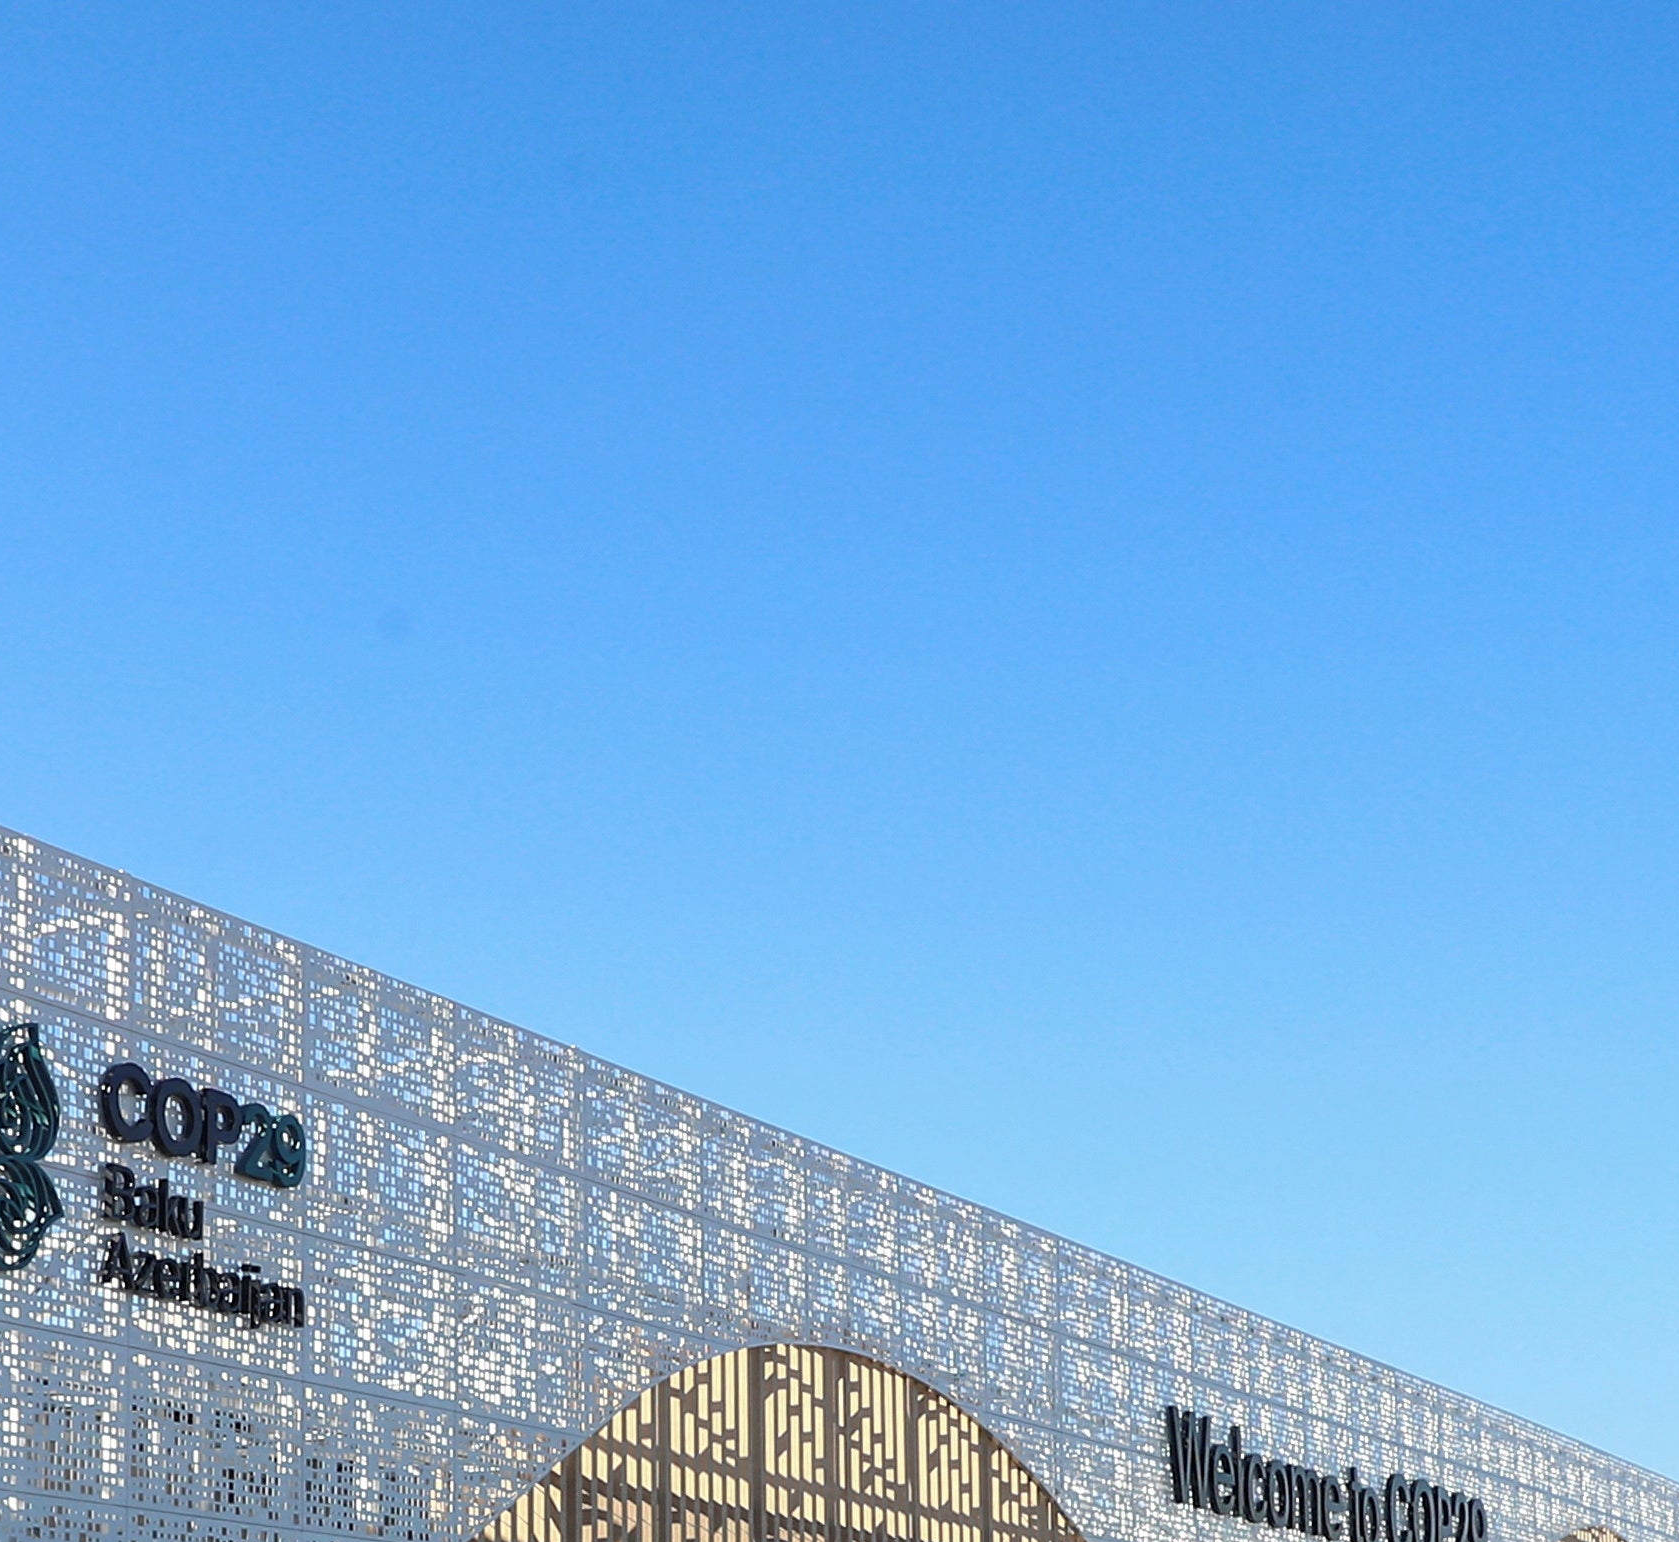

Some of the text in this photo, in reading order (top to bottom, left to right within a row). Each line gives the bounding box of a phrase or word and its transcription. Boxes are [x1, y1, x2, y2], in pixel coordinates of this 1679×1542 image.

[99, 1062, 307, 1187] COP29
[102, 1162, 203, 1240] Baku
[100, 1232, 305, 1328] Azerbaijan
[1166, 1405, 1342, 1541] Welcome
